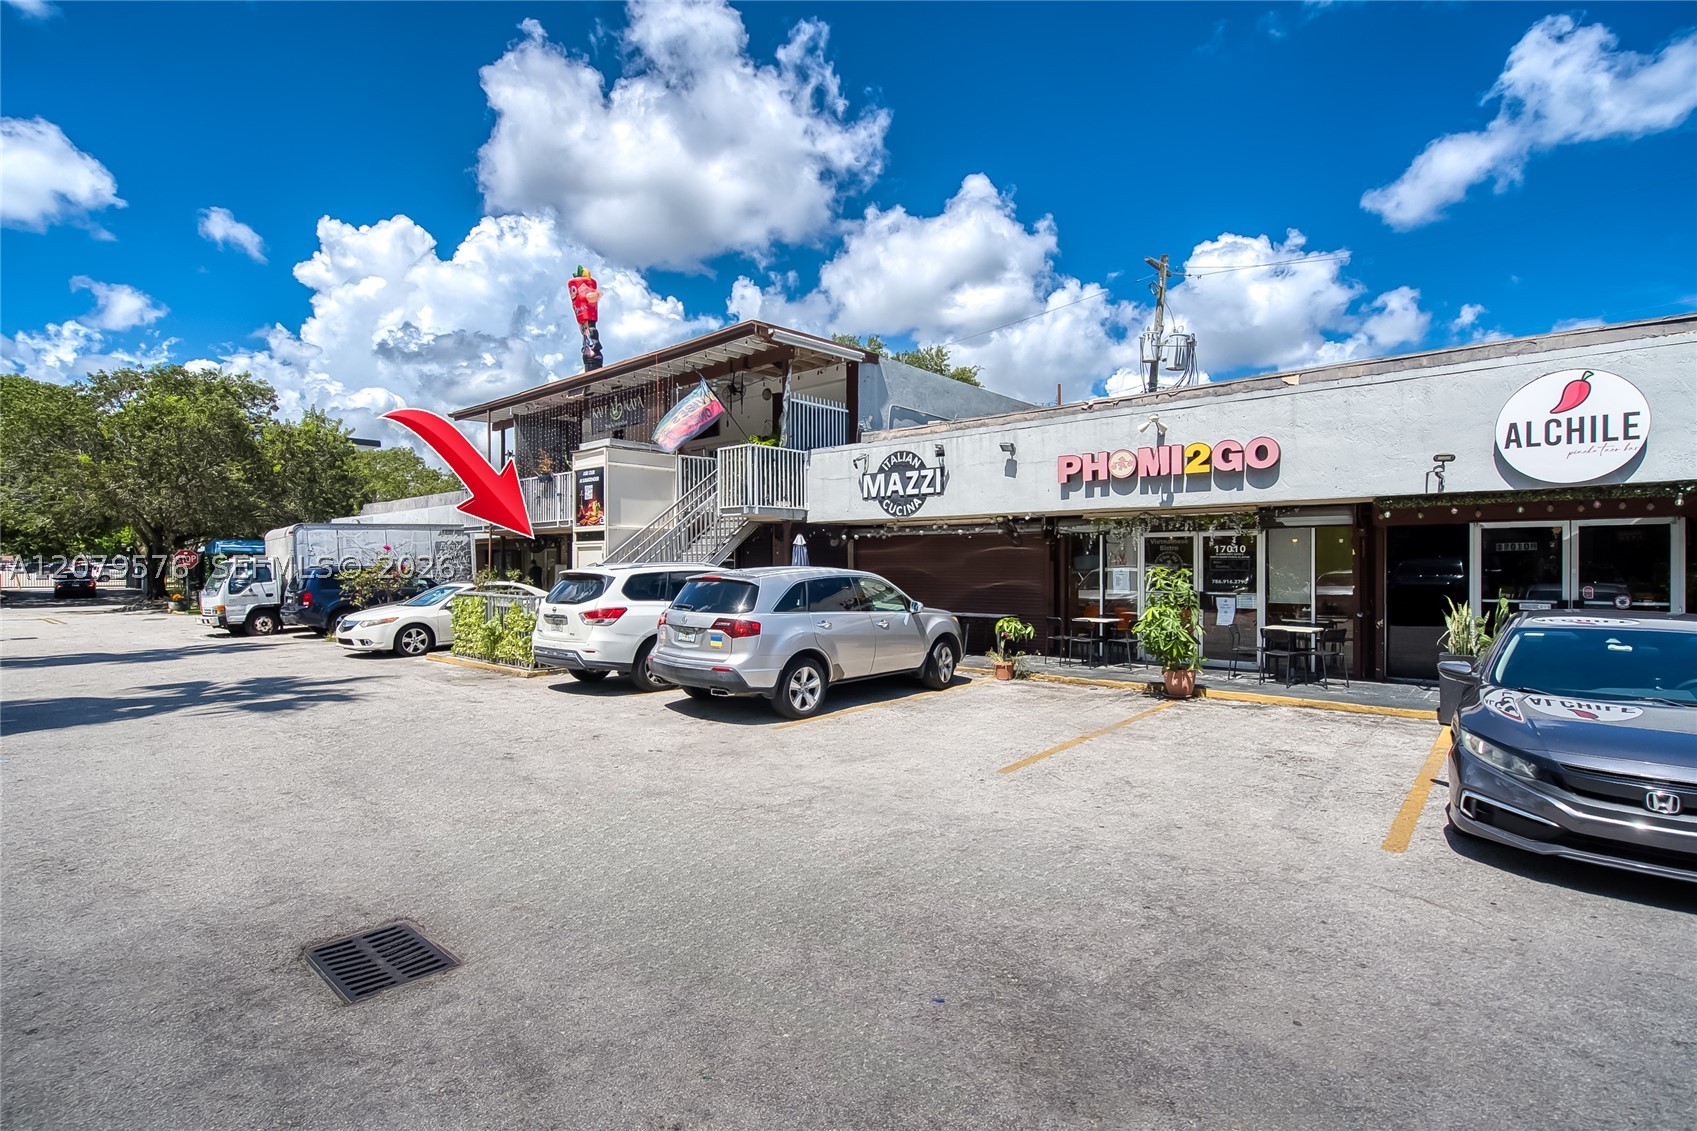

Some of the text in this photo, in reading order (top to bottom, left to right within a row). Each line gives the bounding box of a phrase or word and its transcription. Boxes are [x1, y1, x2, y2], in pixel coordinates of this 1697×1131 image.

[1504, 411, 1641, 450] ALCHILE
[1598, 443, 1619, 457] taco
[881, 452, 922, 471] ITALIAN
[1057, 436, 1281, 484] PHOMI2GO
[863, 468, 941, 498] MAZZI
[882, 498, 922, 516] CUCINA
[1214, 545, 1247, 553] 17010
[176, 555, 197, 565] STOP
